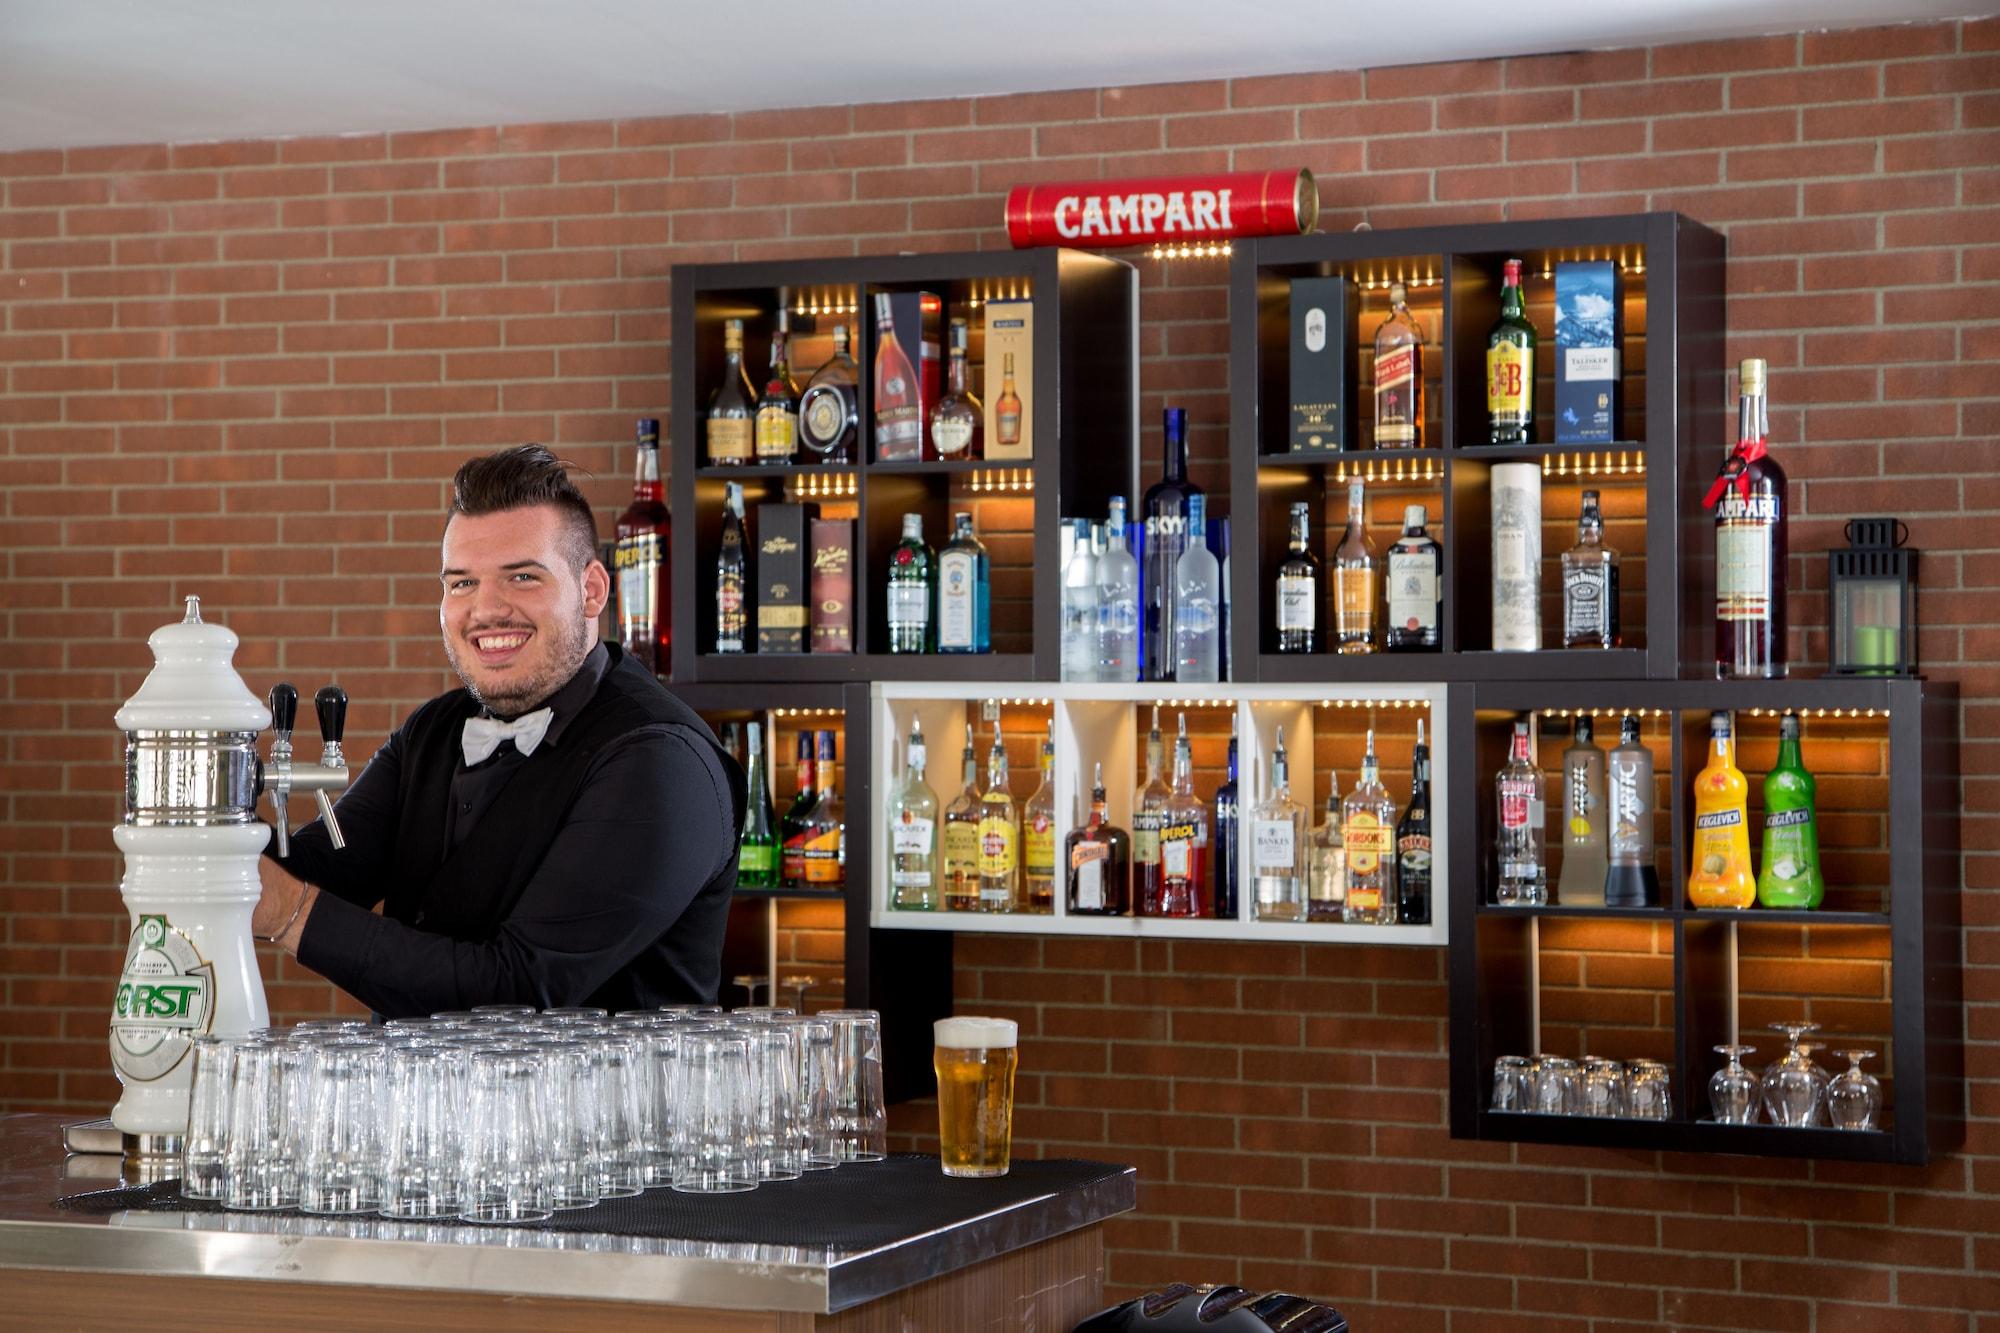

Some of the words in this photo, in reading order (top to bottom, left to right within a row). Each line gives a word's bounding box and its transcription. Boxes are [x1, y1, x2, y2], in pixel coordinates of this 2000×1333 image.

[1055, 189, 1233, 238] CAMPARI
[1716, 499, 1776, 518] AMPARI
[1147, 516, 1187, 535] SKYY
[1698, 811, 1740, 827] KEGLEVICH
[1766, 809, 1809, 827] KEGLEVICH
[1160, 824, 1195, 841] APEROL
[117, 983, 199, 1017] ORST
